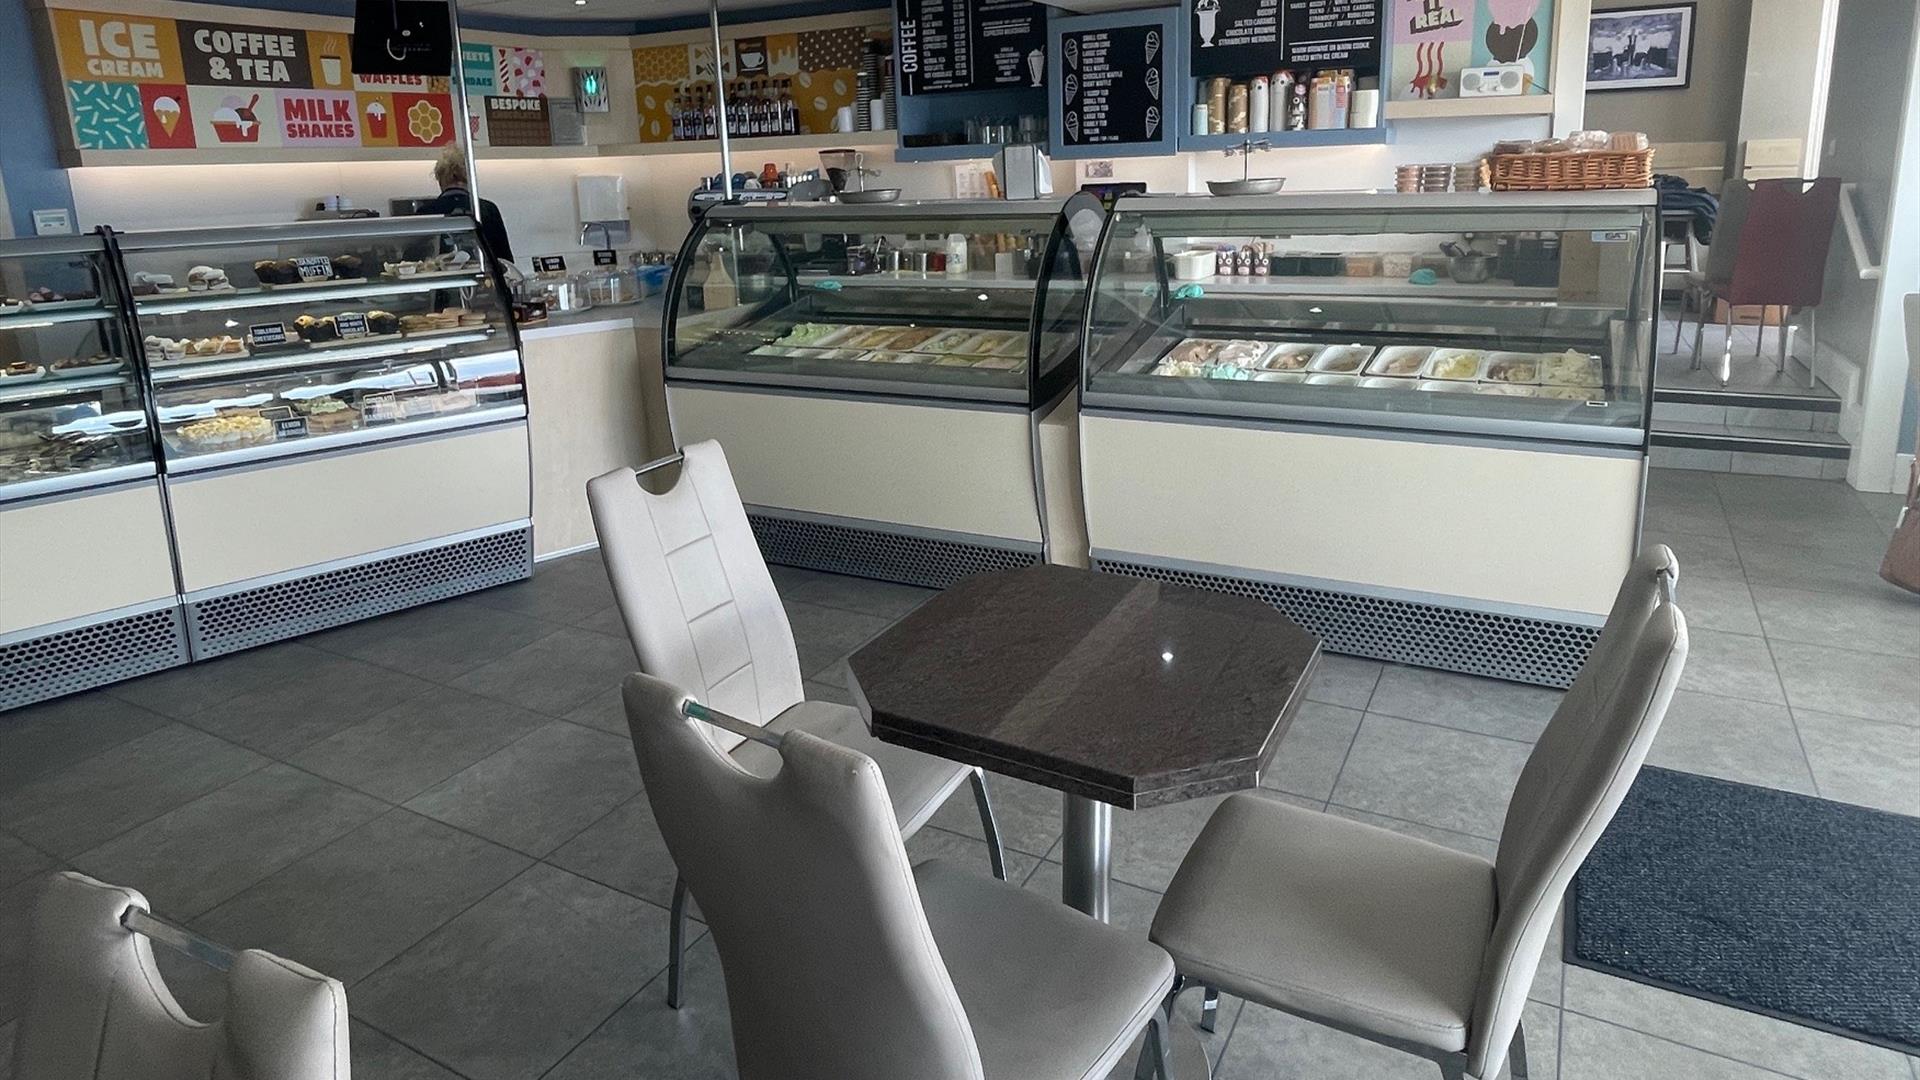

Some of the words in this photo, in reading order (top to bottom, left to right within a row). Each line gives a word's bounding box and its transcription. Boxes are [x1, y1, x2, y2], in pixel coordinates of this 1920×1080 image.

[1410, 8, 1464, 34] REAL
[79, 19, 161, 59] ICE
[193, 29, 297, 58] COFFEE
[900, 19, 918, 73] COFFEE
[86, 58, 164, 78] CREAM
[208, 56, 232, 80] &
[237, 58, 291, 82] TEA
[283, 98, 353, 121] MILK
[491, 98, 541, 111] BESPOKE
[286, 123, 355, 139] SHAKES
[300, 265, 332, 277] MUFFIN
